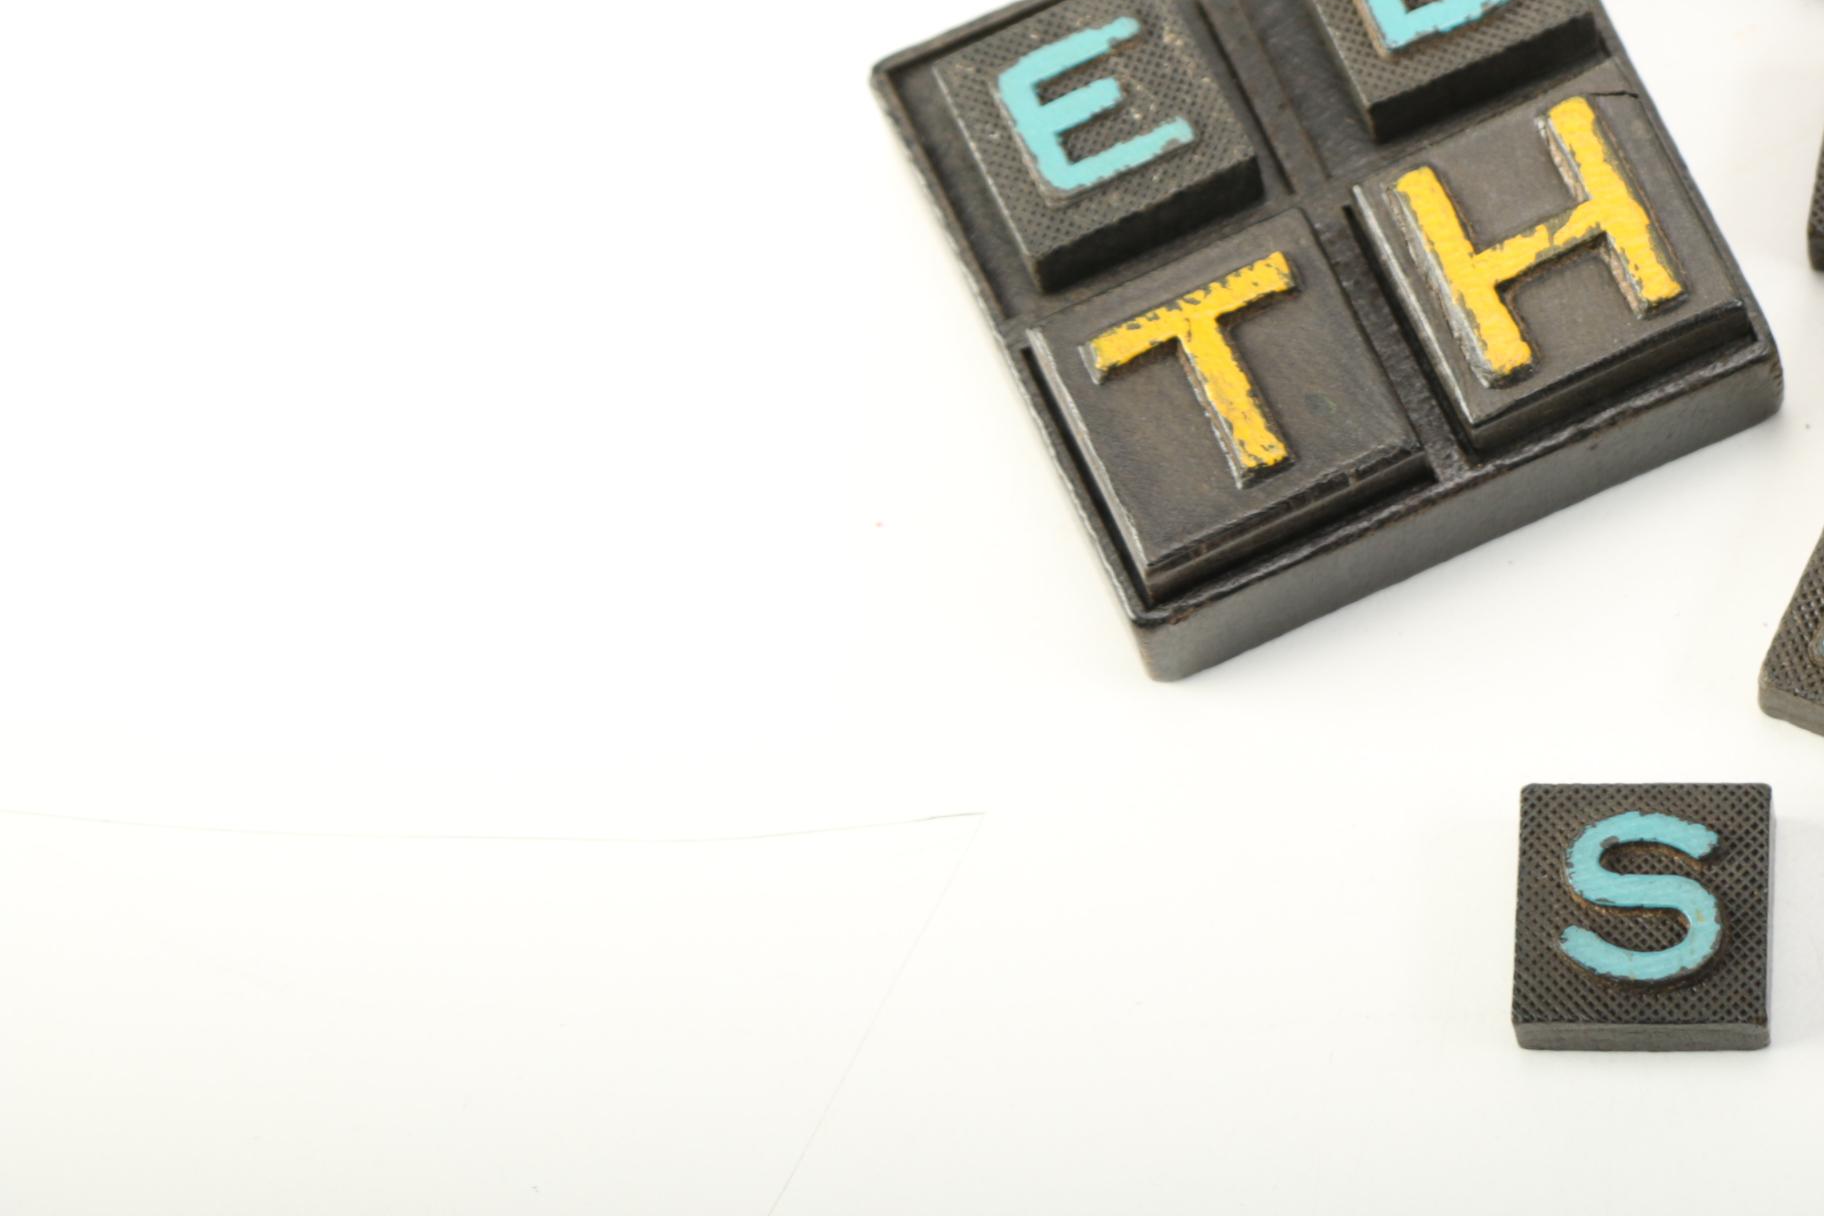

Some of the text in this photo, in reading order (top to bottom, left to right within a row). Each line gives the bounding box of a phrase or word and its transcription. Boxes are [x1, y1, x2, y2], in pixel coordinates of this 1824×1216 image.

[996, 17, 1193, 189] E
[1395, 96, 1683, 375] H
[1091, 251, 1291, 472] T
[1562, 811, 1720, 981] S
